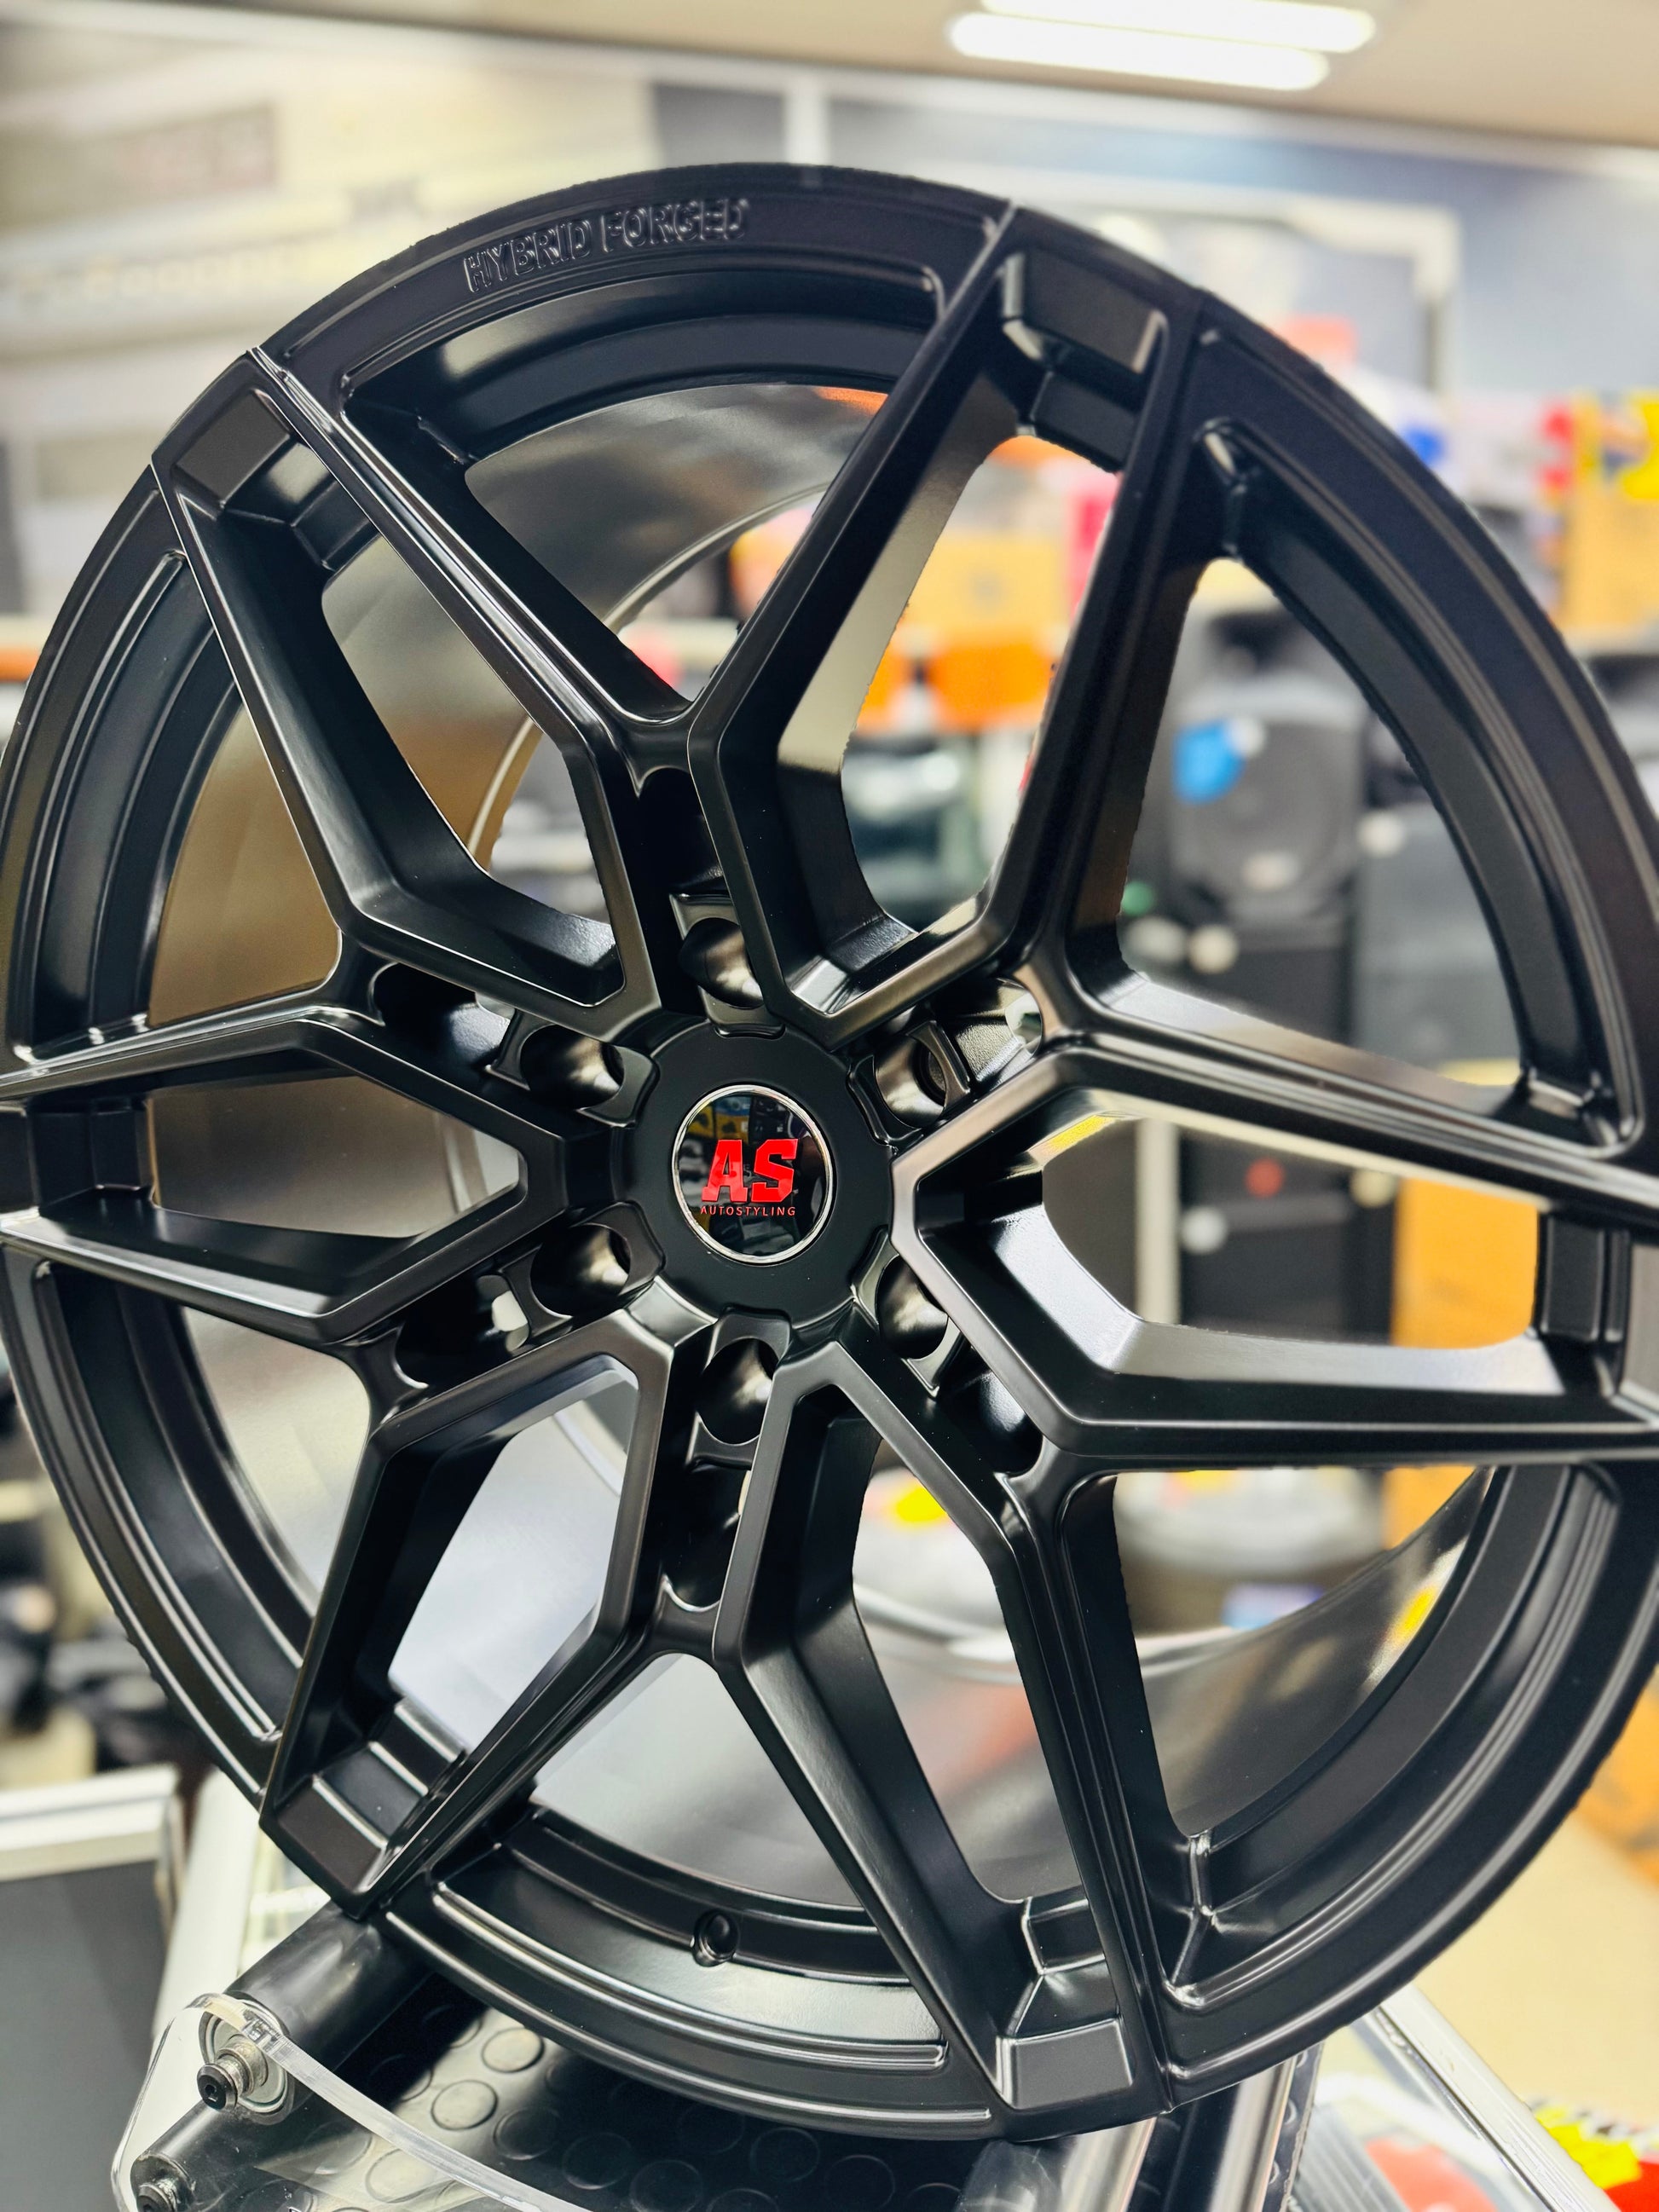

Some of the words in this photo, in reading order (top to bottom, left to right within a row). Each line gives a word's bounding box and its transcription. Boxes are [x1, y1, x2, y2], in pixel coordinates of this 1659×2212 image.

[463, 219, 592, 292] HYBRID
[601, 199, 749, 252] FORGED
[702, 1138, 799, 1202] AS
[700, 1205, 796, 1216] AUTOSTYLING
